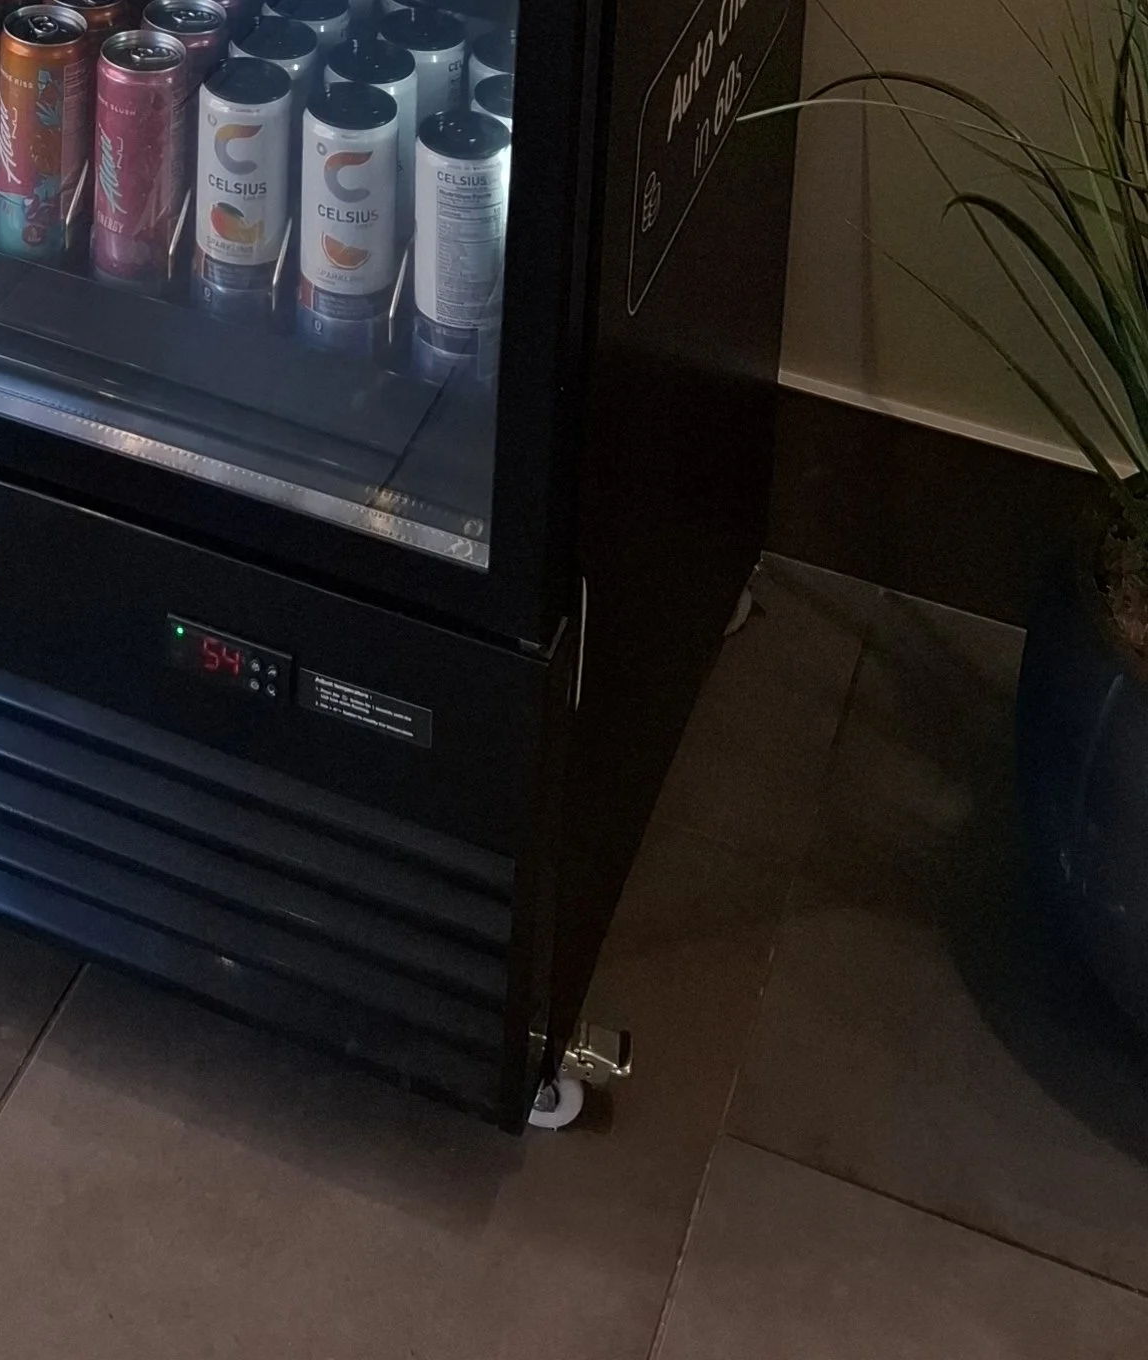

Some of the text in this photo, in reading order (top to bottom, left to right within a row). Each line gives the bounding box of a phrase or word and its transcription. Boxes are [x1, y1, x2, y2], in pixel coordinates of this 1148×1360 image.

[667, 29, 714, 143] Auto
[693, 53, 743, 178] in 60s
[208, 173, 268, 196] CELSIUS
[436, 170, 488, 186] CELSIUS
[317, 203, 379, 224] CELSIUS
[204, 638, 239, 674] 54
